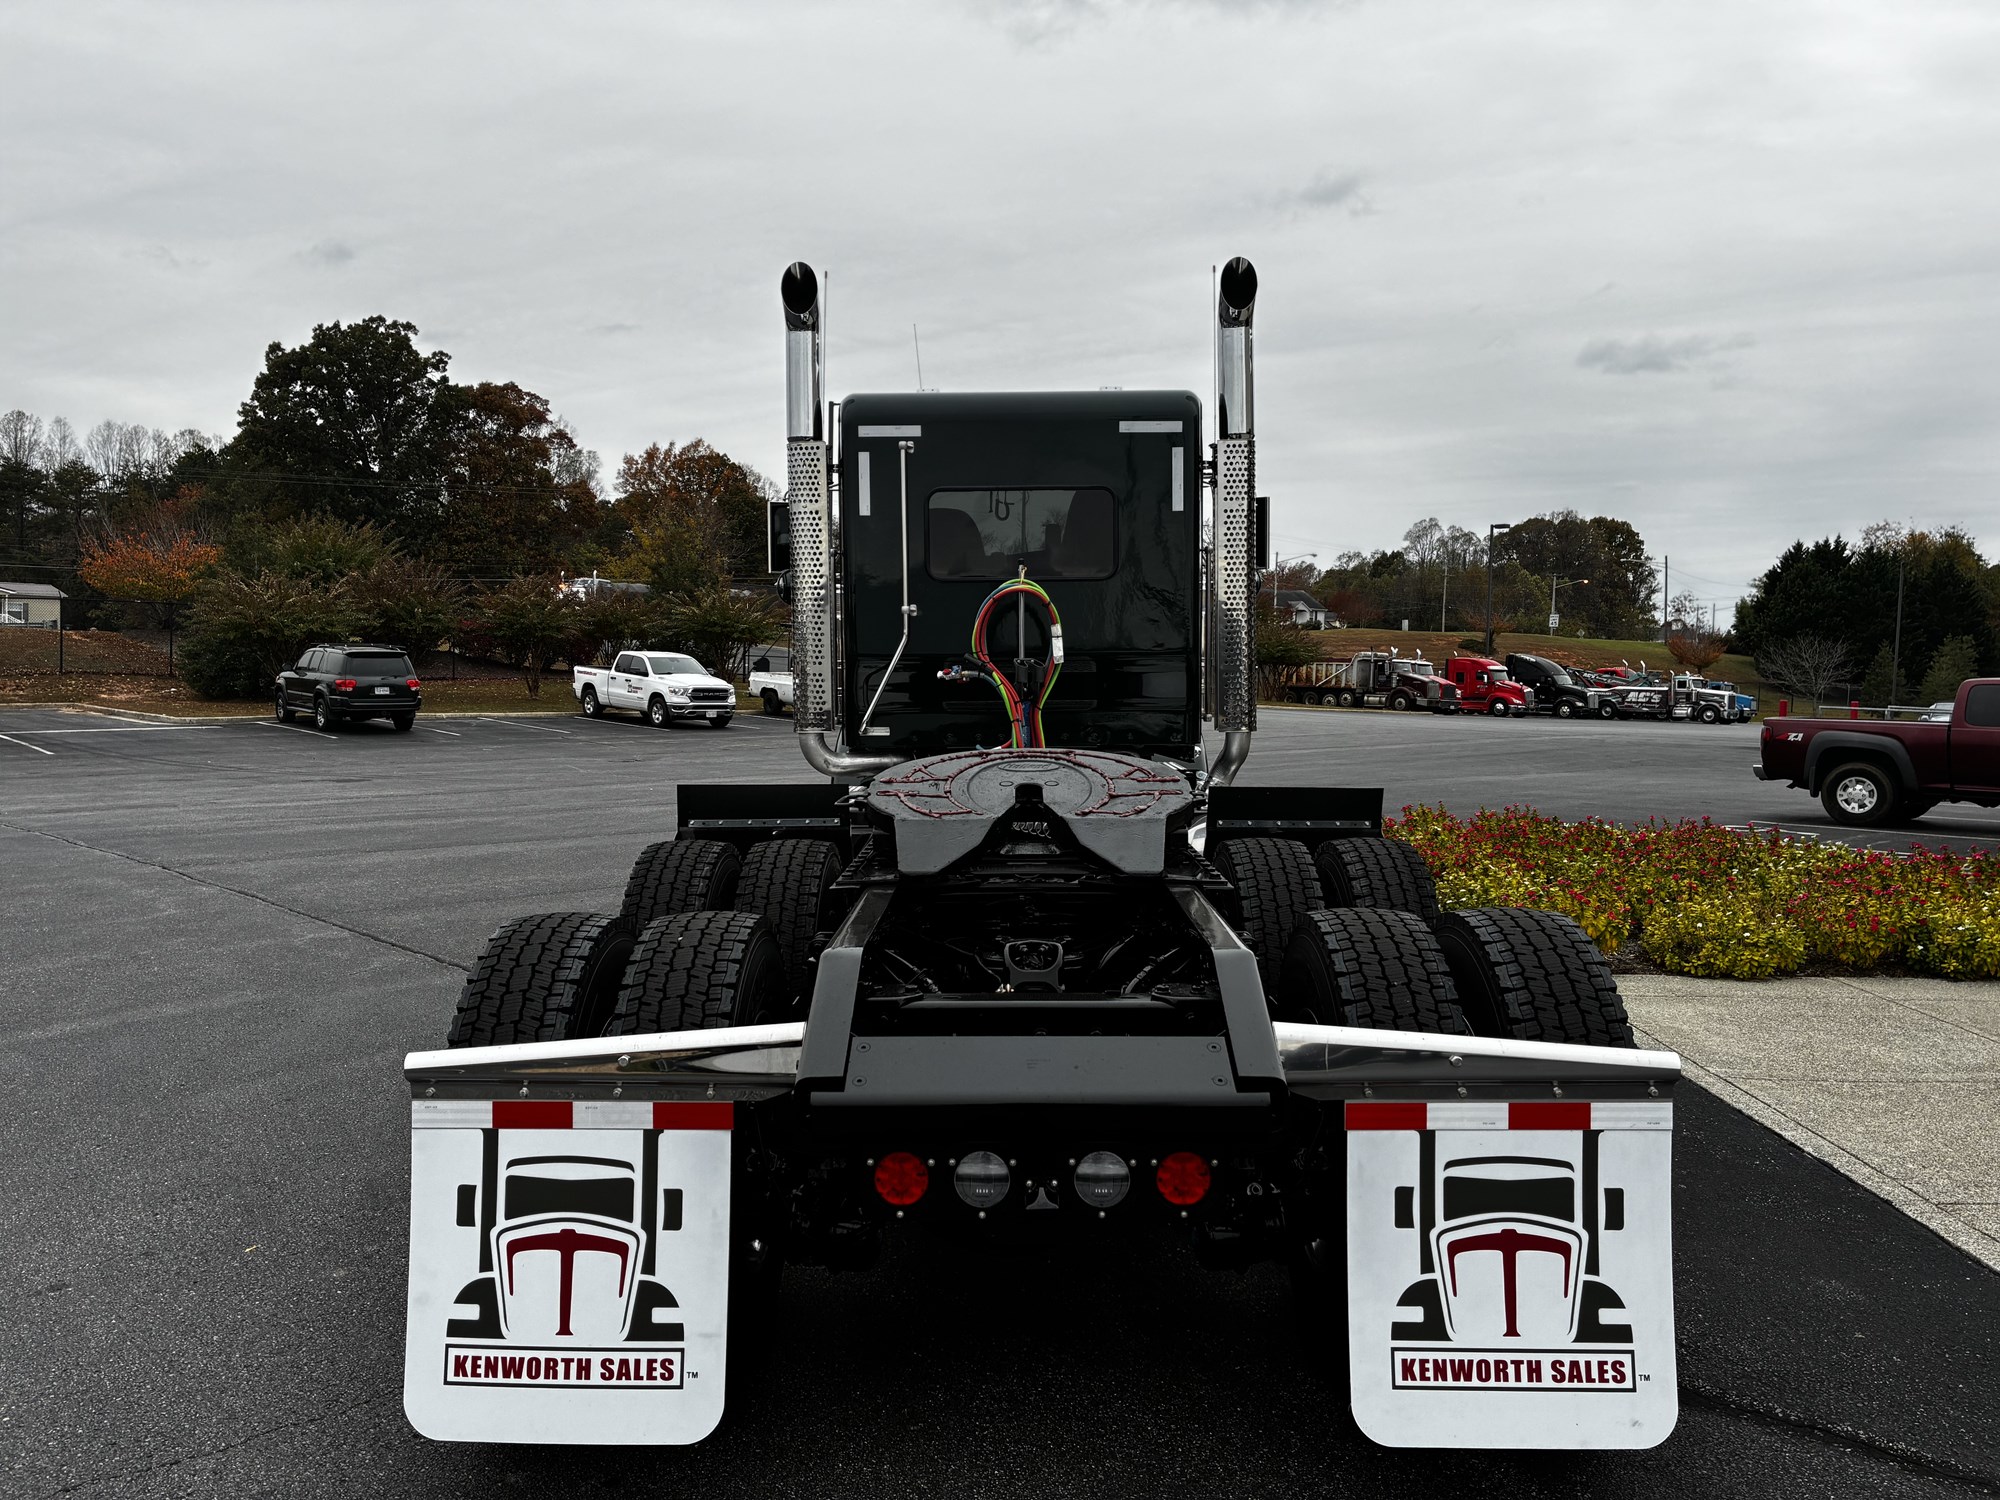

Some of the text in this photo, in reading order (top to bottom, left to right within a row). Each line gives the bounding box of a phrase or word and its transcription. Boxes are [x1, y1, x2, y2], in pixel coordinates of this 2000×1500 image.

[453, 1354, 699, 1381] KENWORTH SALES TM
[1401, 1358, 1651, 1384] KENWORTH SALES TM
